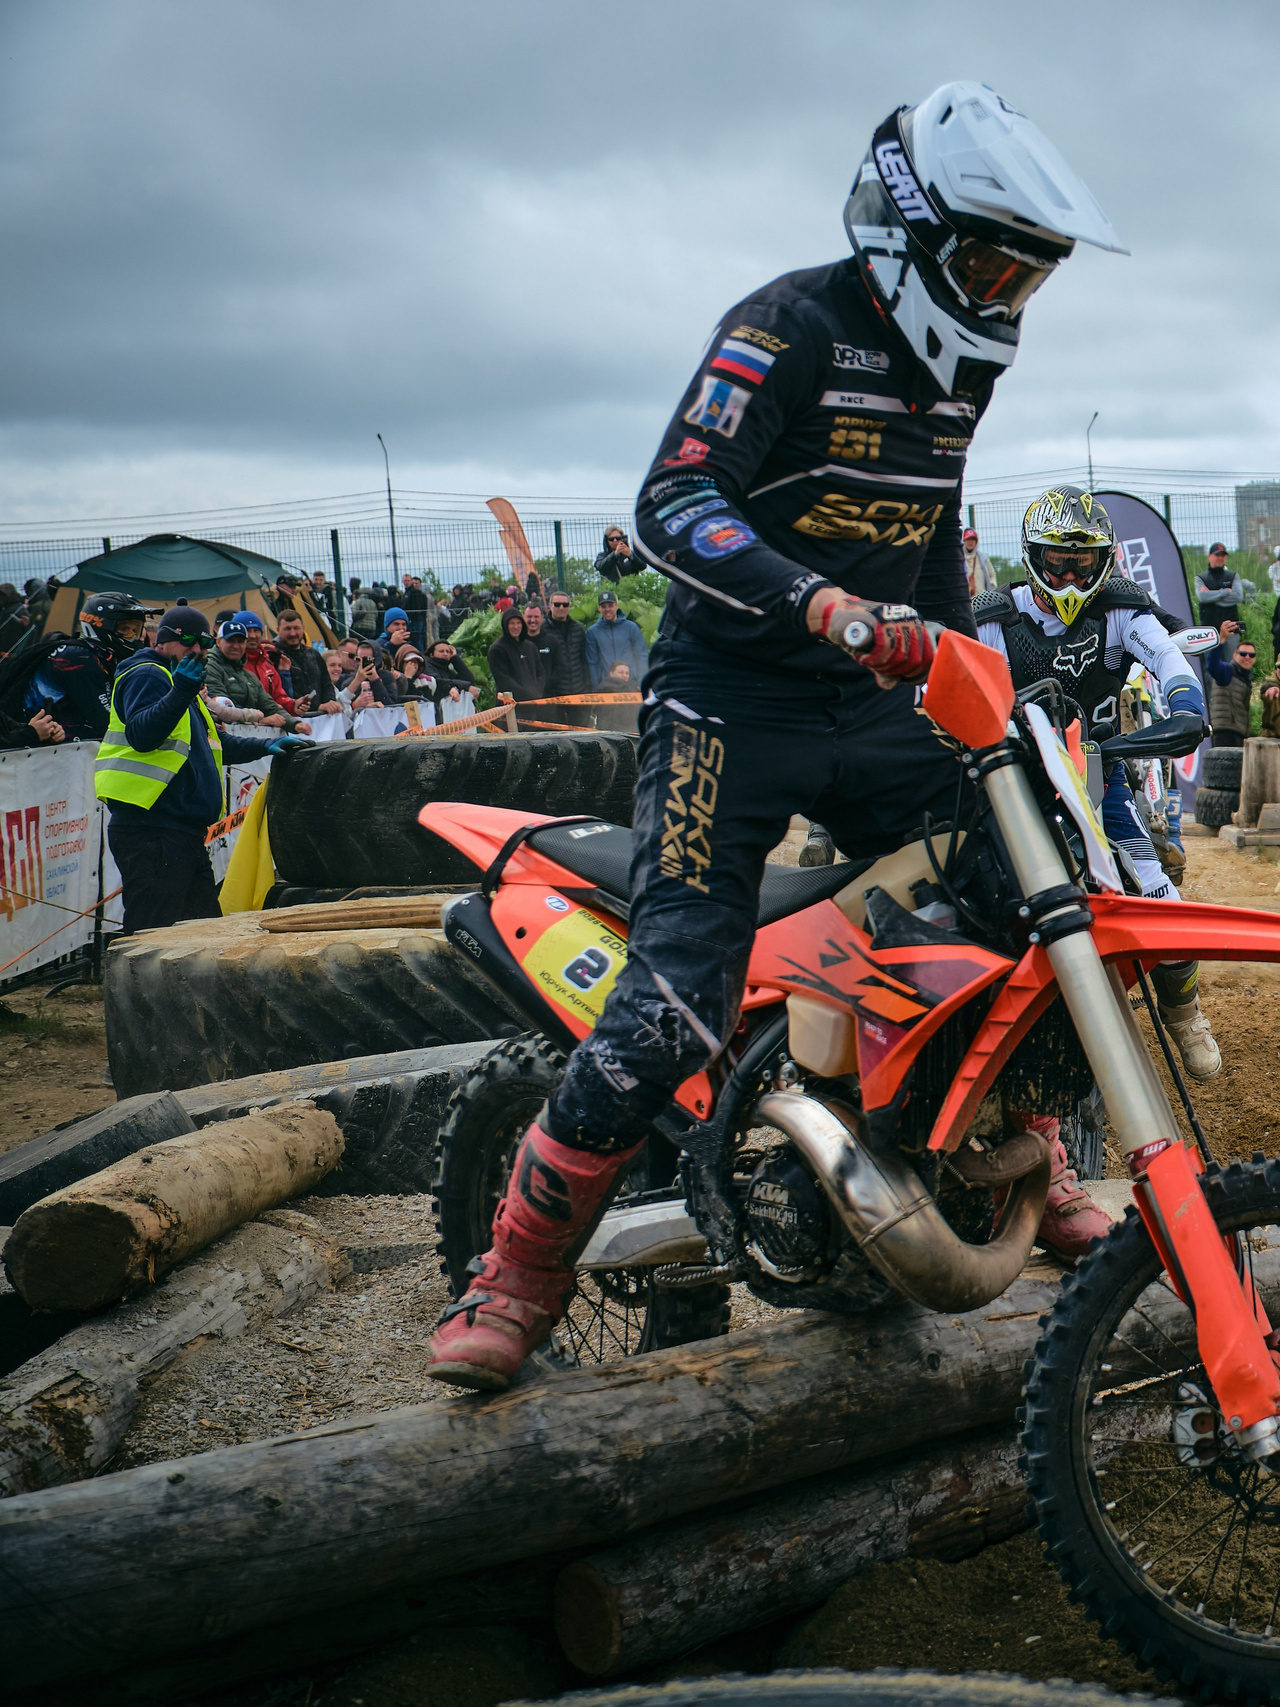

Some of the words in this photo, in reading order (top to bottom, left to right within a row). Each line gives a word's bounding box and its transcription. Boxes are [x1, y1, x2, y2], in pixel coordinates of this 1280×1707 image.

[876, 141, 942, 226] LEATT
[935, 232, 959, 265] LEATT
[827, 429, 882, 460] 131
[45, 800, 67, 818] ЦЕНТР
[44, 814, 89, 839] СПОРТИВНОЙ
[210, 820, 227, 841] KTM
[46, 838, 87, 861] ПОДГОТОВКИ
[455, 927, 483, 958] KTM
[563, 945, 613, 992] 2
[540, 969, 569, 996] Юрчук
[1143, 1140, 1167, 1157] WP
[752, 1181, 790, 1205] KTM
